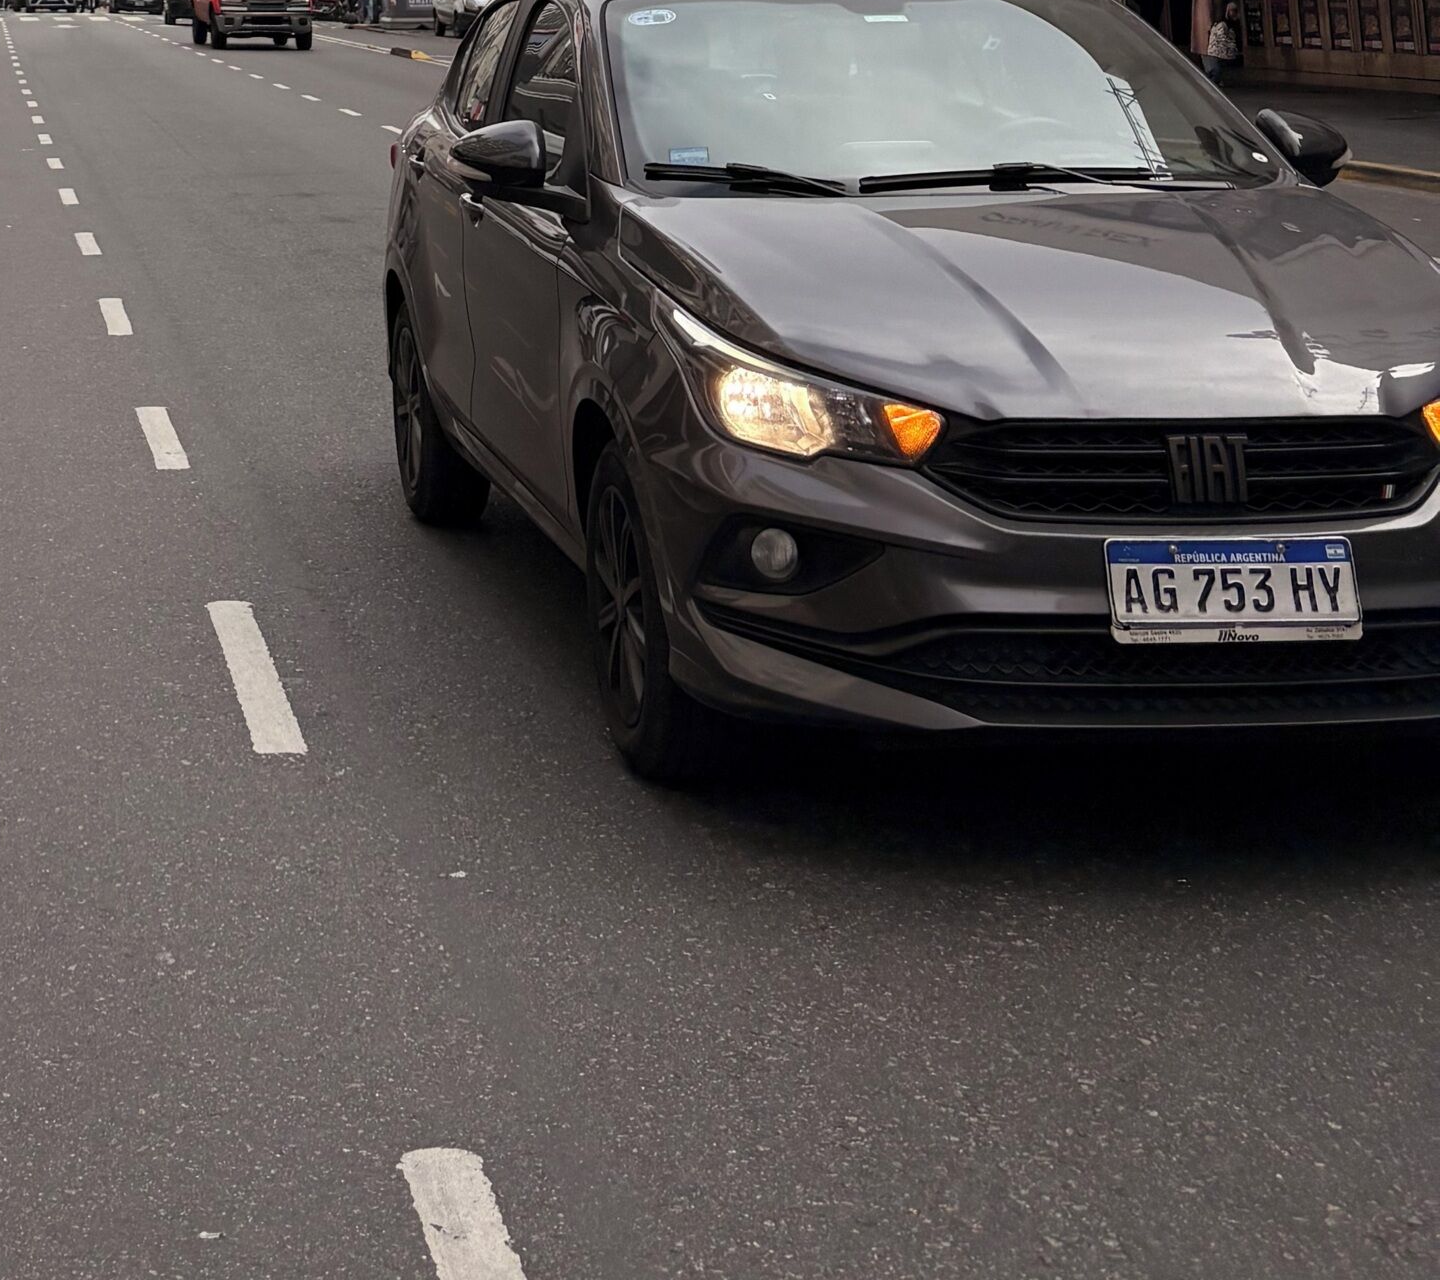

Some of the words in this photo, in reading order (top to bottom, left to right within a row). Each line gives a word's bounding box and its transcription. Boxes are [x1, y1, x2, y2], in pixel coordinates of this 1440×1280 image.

[1166, 433, 1248, 503] FIAT
[1174, 550, 1227, 563] REPÚBLICA
[1230, 552, 1286, 563] ARGENTINA
[1124, 567, 1179, 614] AG
[1192, 567, 1276, 614] 753
[1289, 566, 1341, 613] HY
